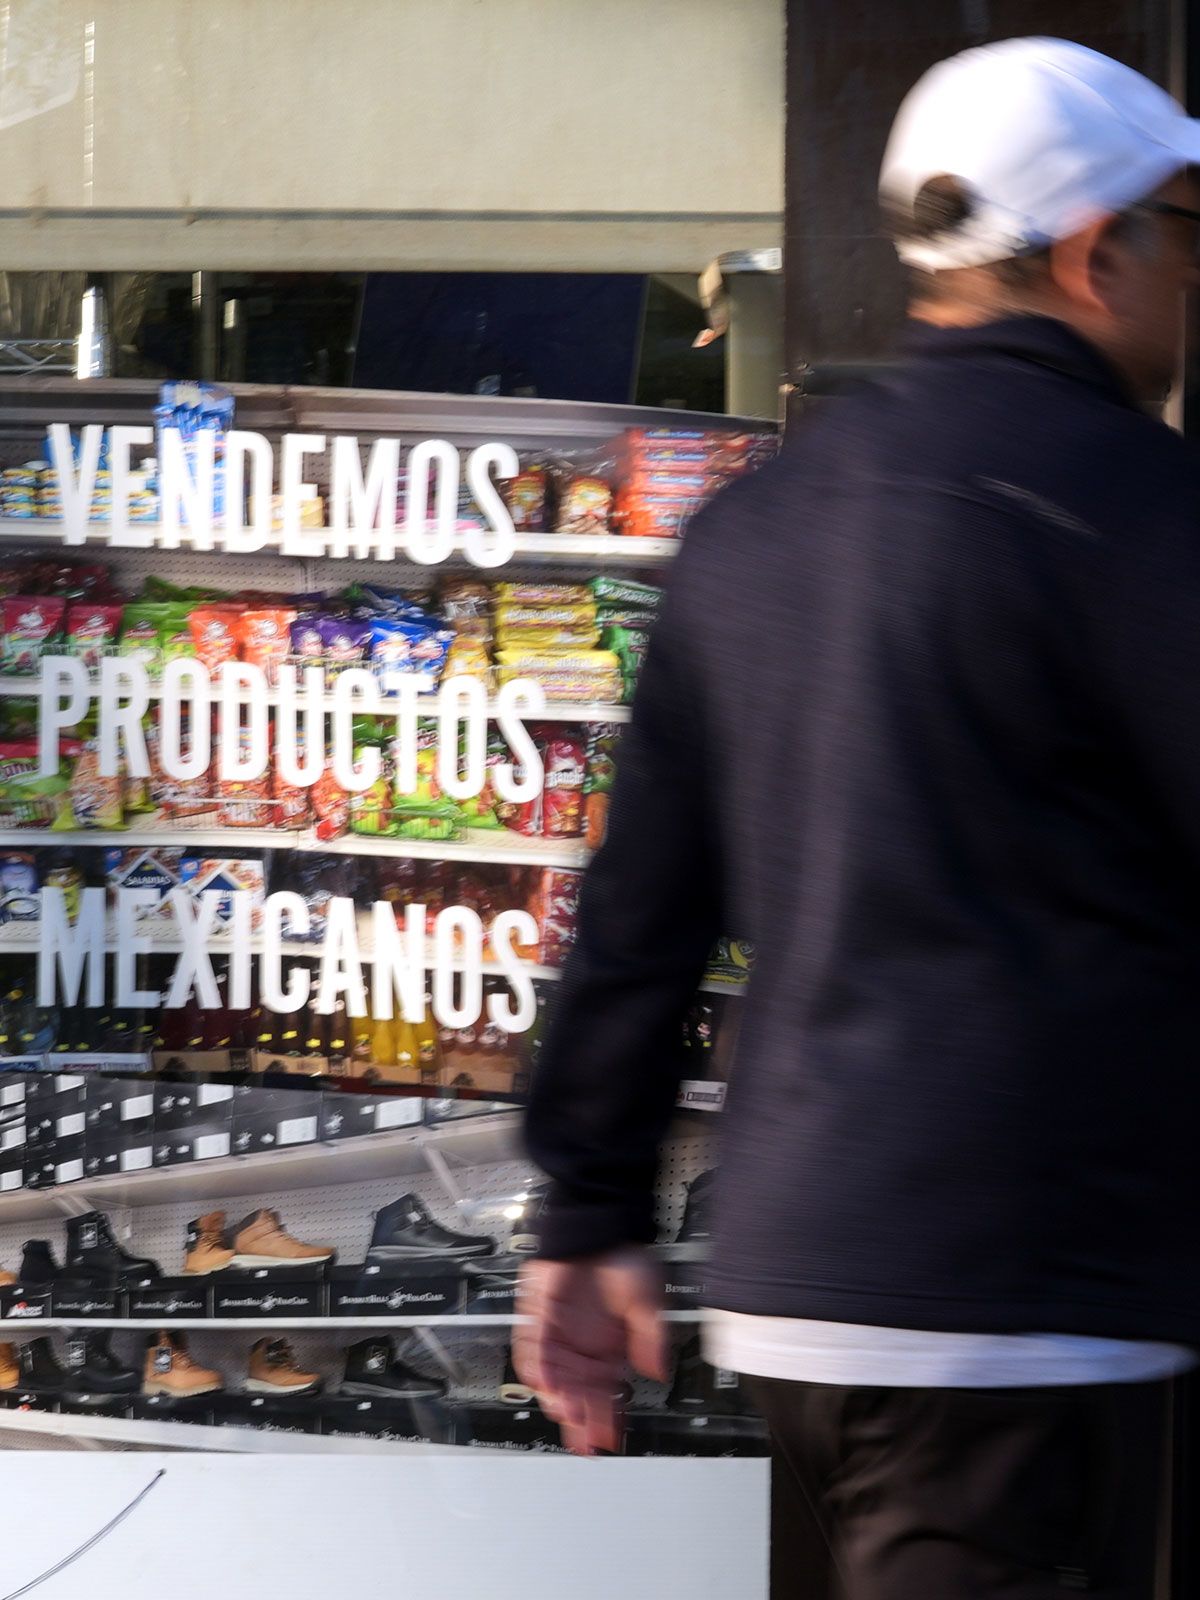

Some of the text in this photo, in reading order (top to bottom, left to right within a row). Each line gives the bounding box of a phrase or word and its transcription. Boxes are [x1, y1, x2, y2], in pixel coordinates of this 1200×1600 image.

[47, 423, 519, 567] VENDEMOS
[39, 655, 547, 802] PRODUCTOS
[37, 886, 540, 1033] MEXICANOS
